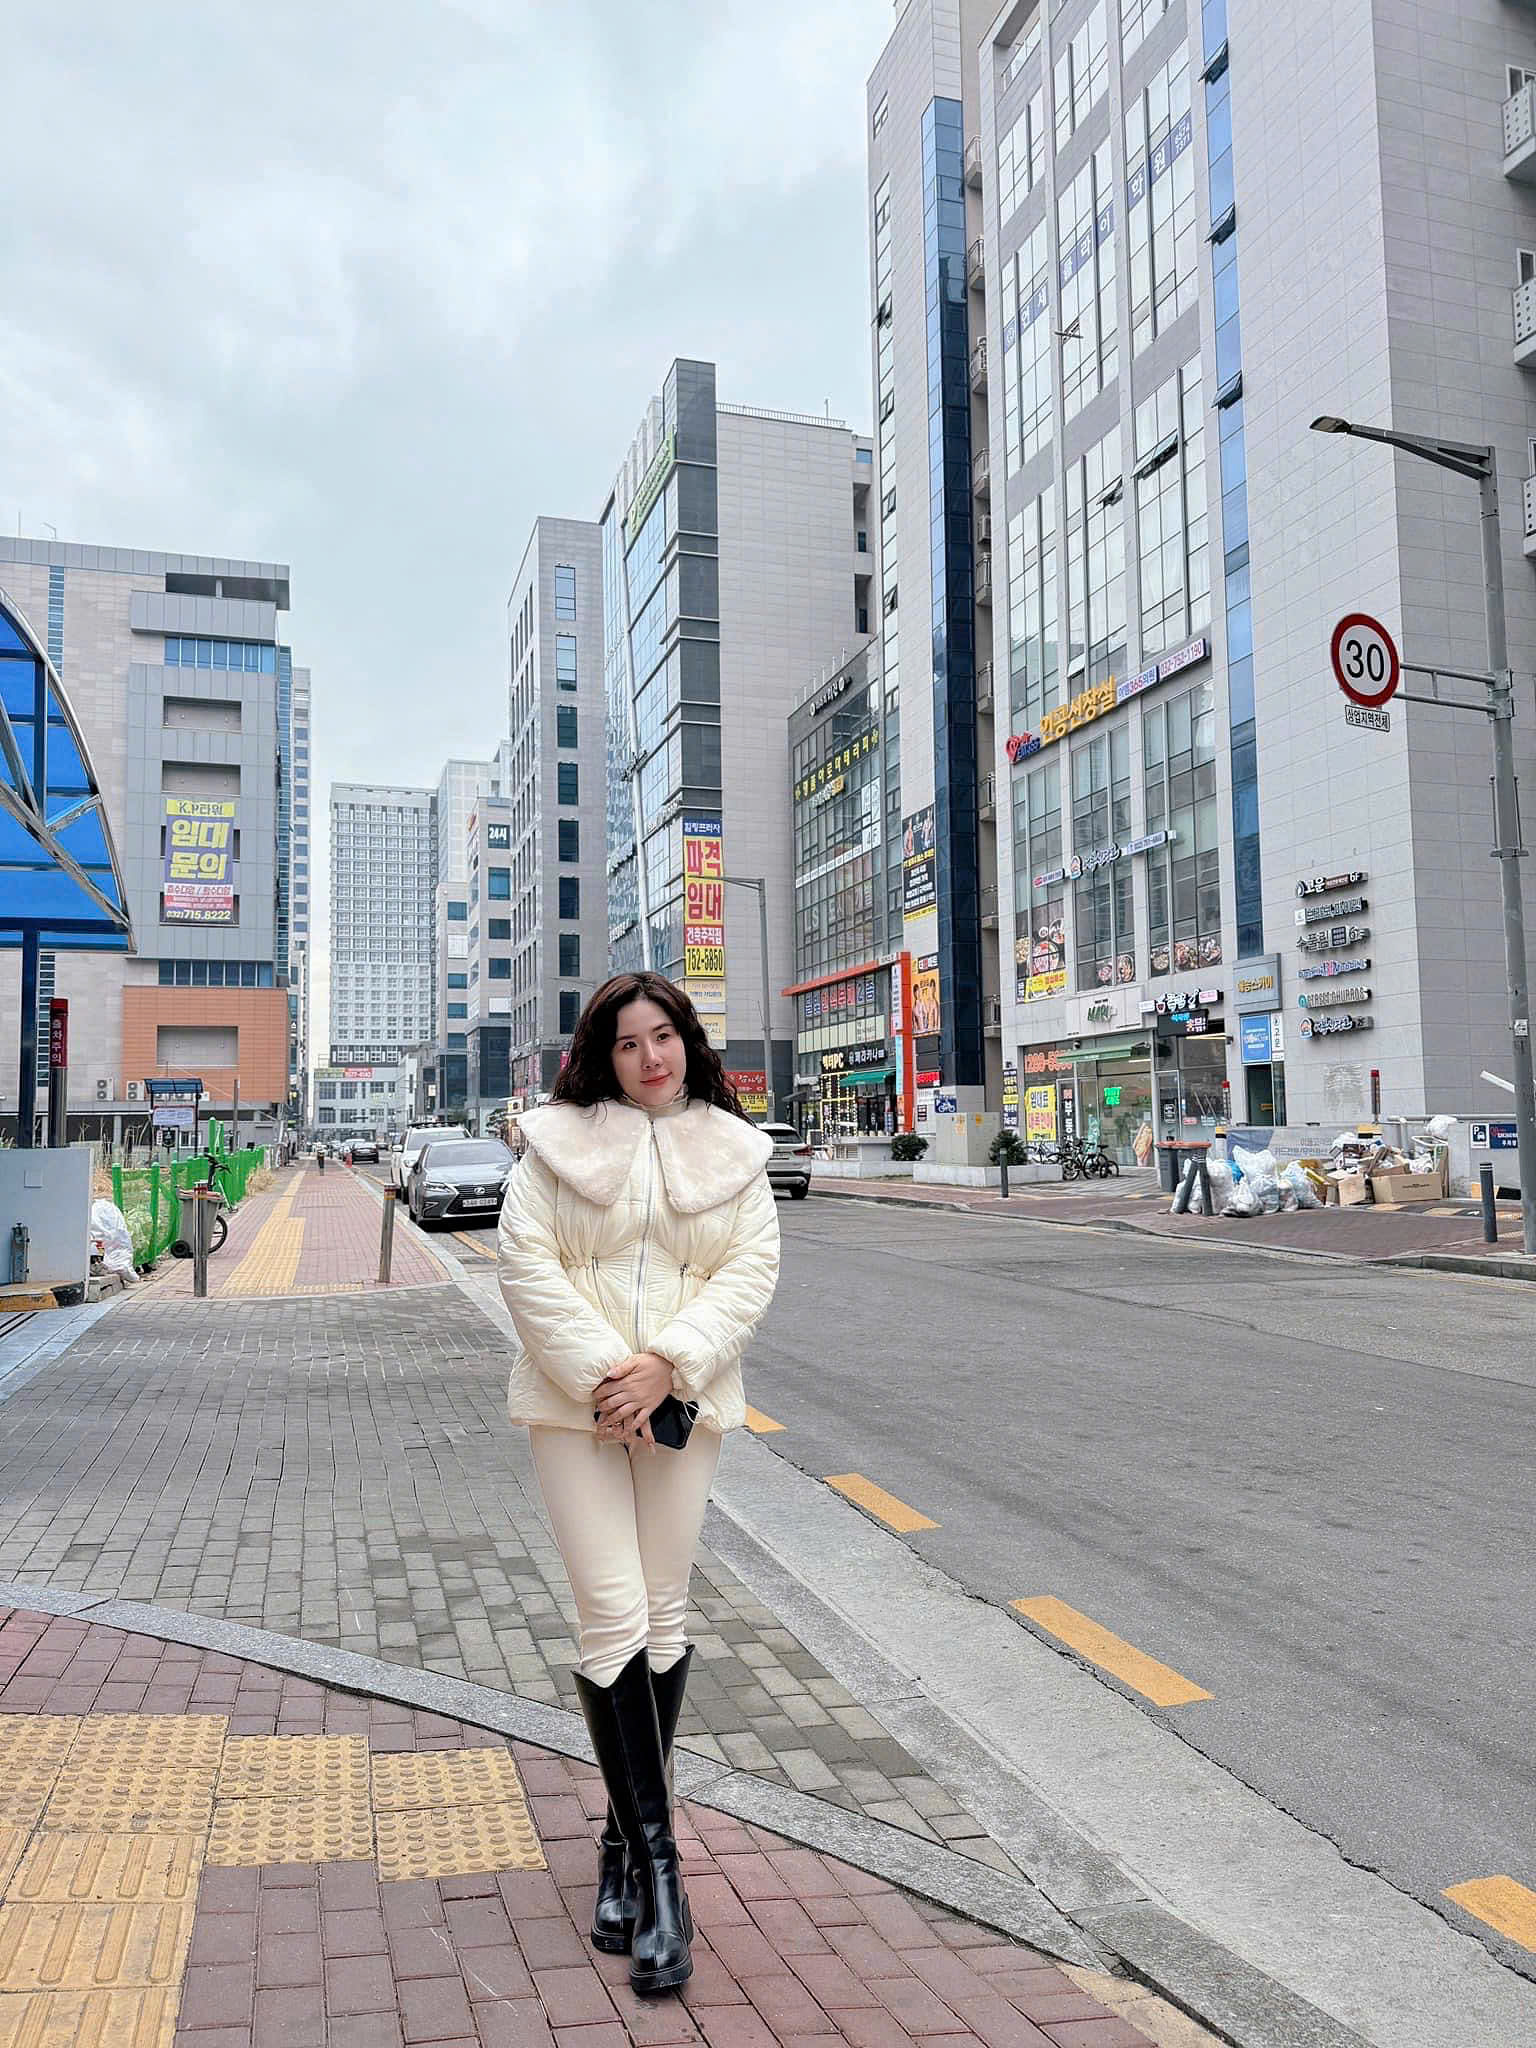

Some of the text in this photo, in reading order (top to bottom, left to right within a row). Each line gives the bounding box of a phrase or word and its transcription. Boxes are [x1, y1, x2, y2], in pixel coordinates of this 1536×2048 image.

[1346, 639, 1384, 682] 30
[1040, 675, 1117, 746] 인공신장실
[1347, 710, 1389, 729] 상업지역전체
[171, 819, 230, 849] 임대
[488, 826, 507, 841] 24시
[169, 851, 229, 881] 문의
[686, 839, 721, 878] 파격
[1304, 877, 1325, 893] 고운
[687, 882, 722, 921] 임대
[1296, 929, 1329, 953] 수풀림
[687, 948, 723, 972] 752-5850
[1331, 986, 1363, 1004] CHURROS
[52, 1018, 62, 1064] 출차주의
[1473, 1126, 1480, 1135] P
